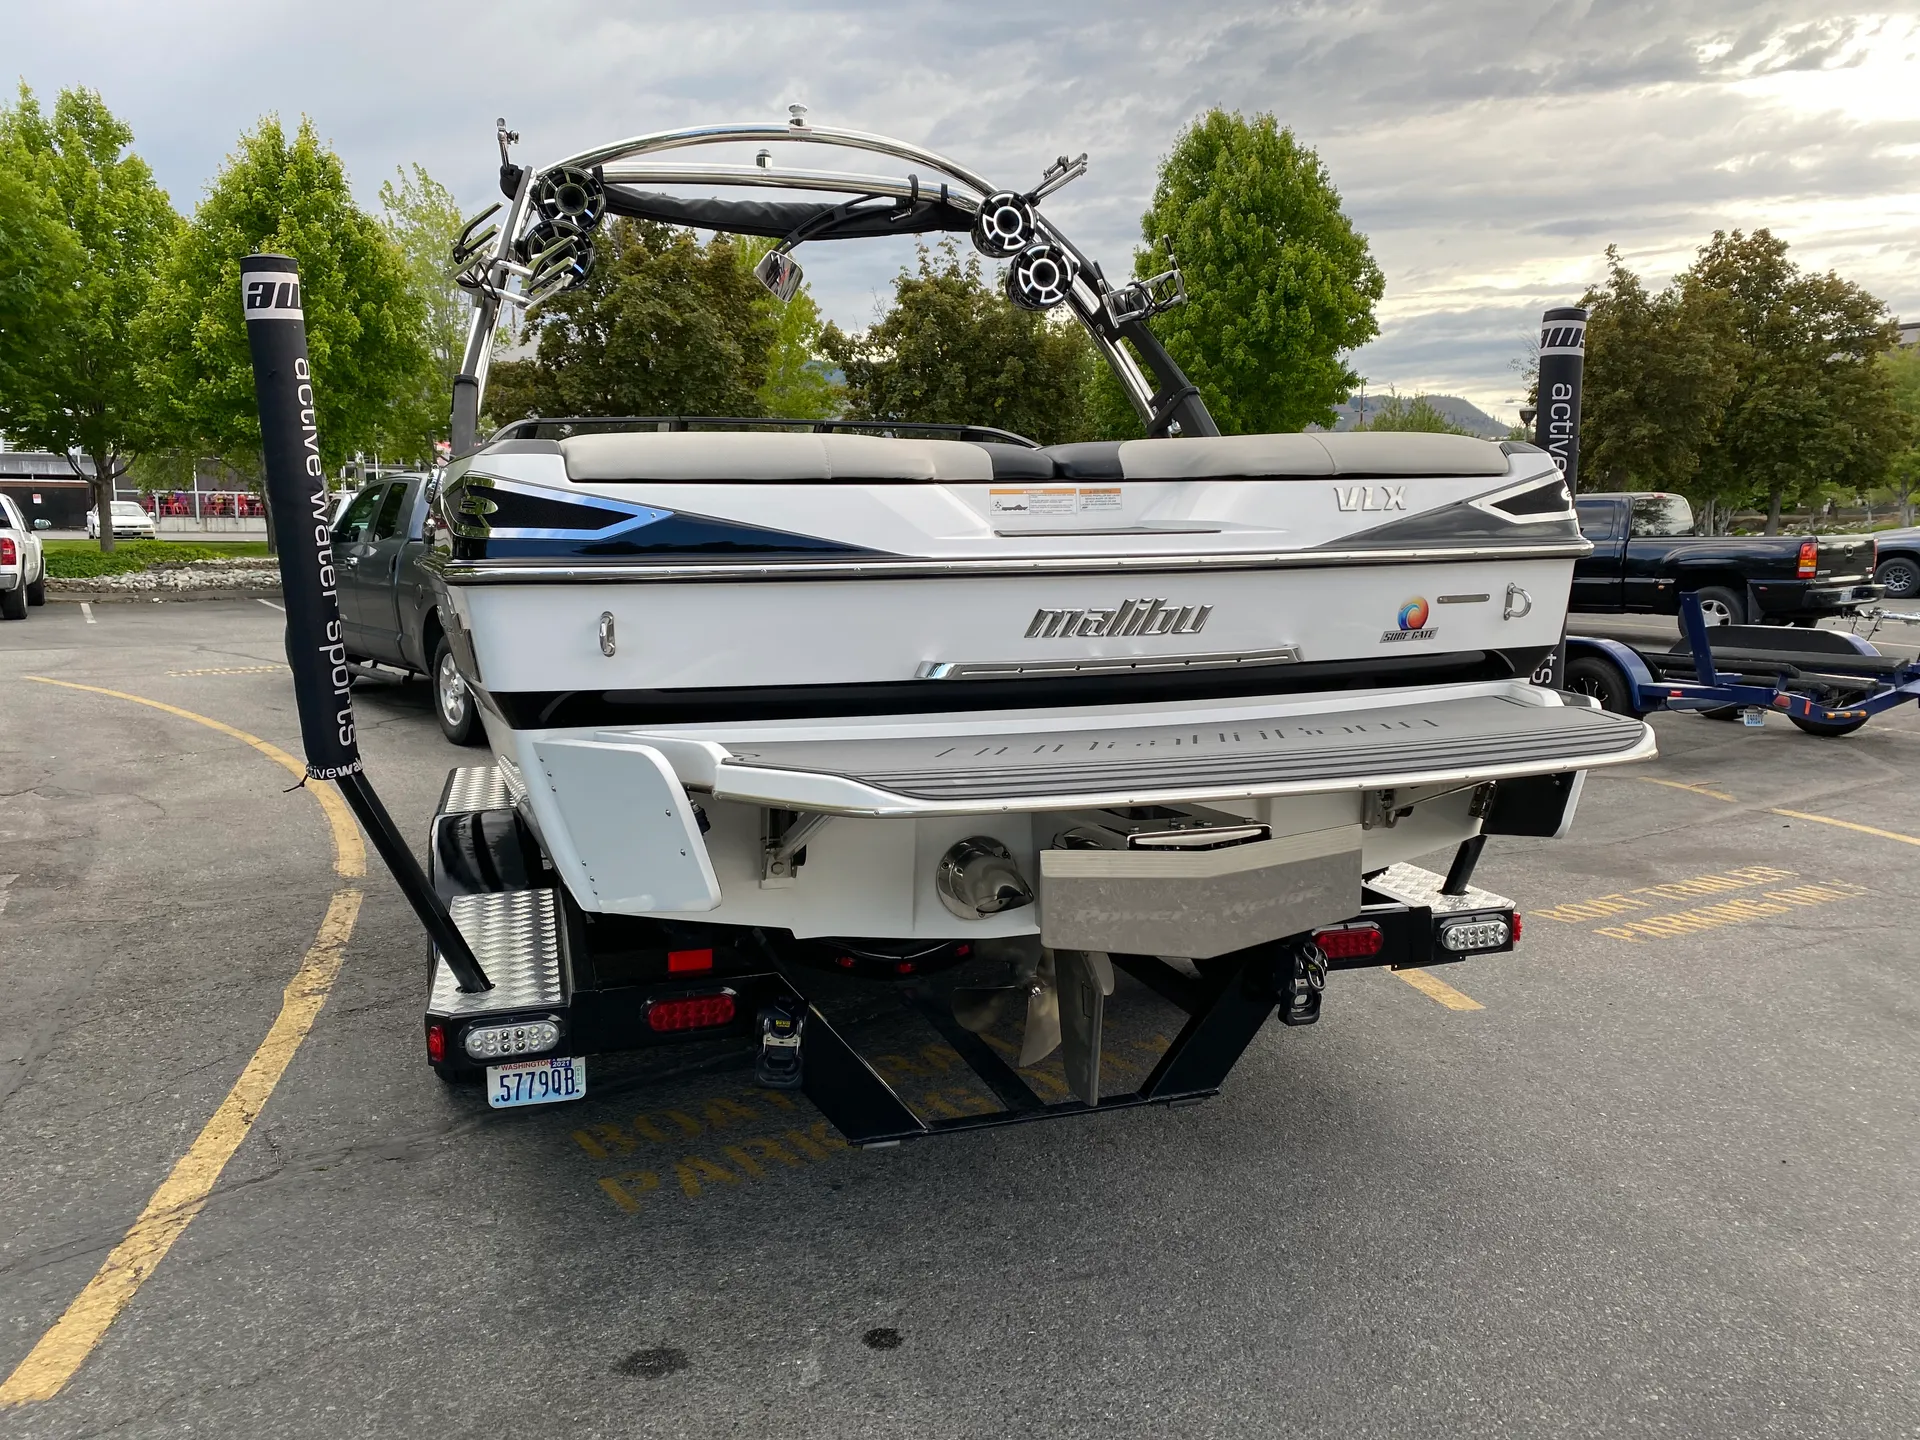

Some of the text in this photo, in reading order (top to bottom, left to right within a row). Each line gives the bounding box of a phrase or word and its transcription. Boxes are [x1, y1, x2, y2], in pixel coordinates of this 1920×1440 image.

[1548, 383, 1574, 473] active
[1333, 486, 1407, 511] VLX
[294, 357, 357, 747] active water sports
[1024, 598, 1214, 638] malibu
[1383, 629, 1435, 641] SURF GATE
[1527, 894, 1655, 924] BOAT
[1592, 899, 1794, 943] PARKING
[501, 1060, 570, 1071] WASHINGTON 2021
[499, 1067, 575, 1102] 5779QB
[571, 1088, 799, 1161] BOAT
